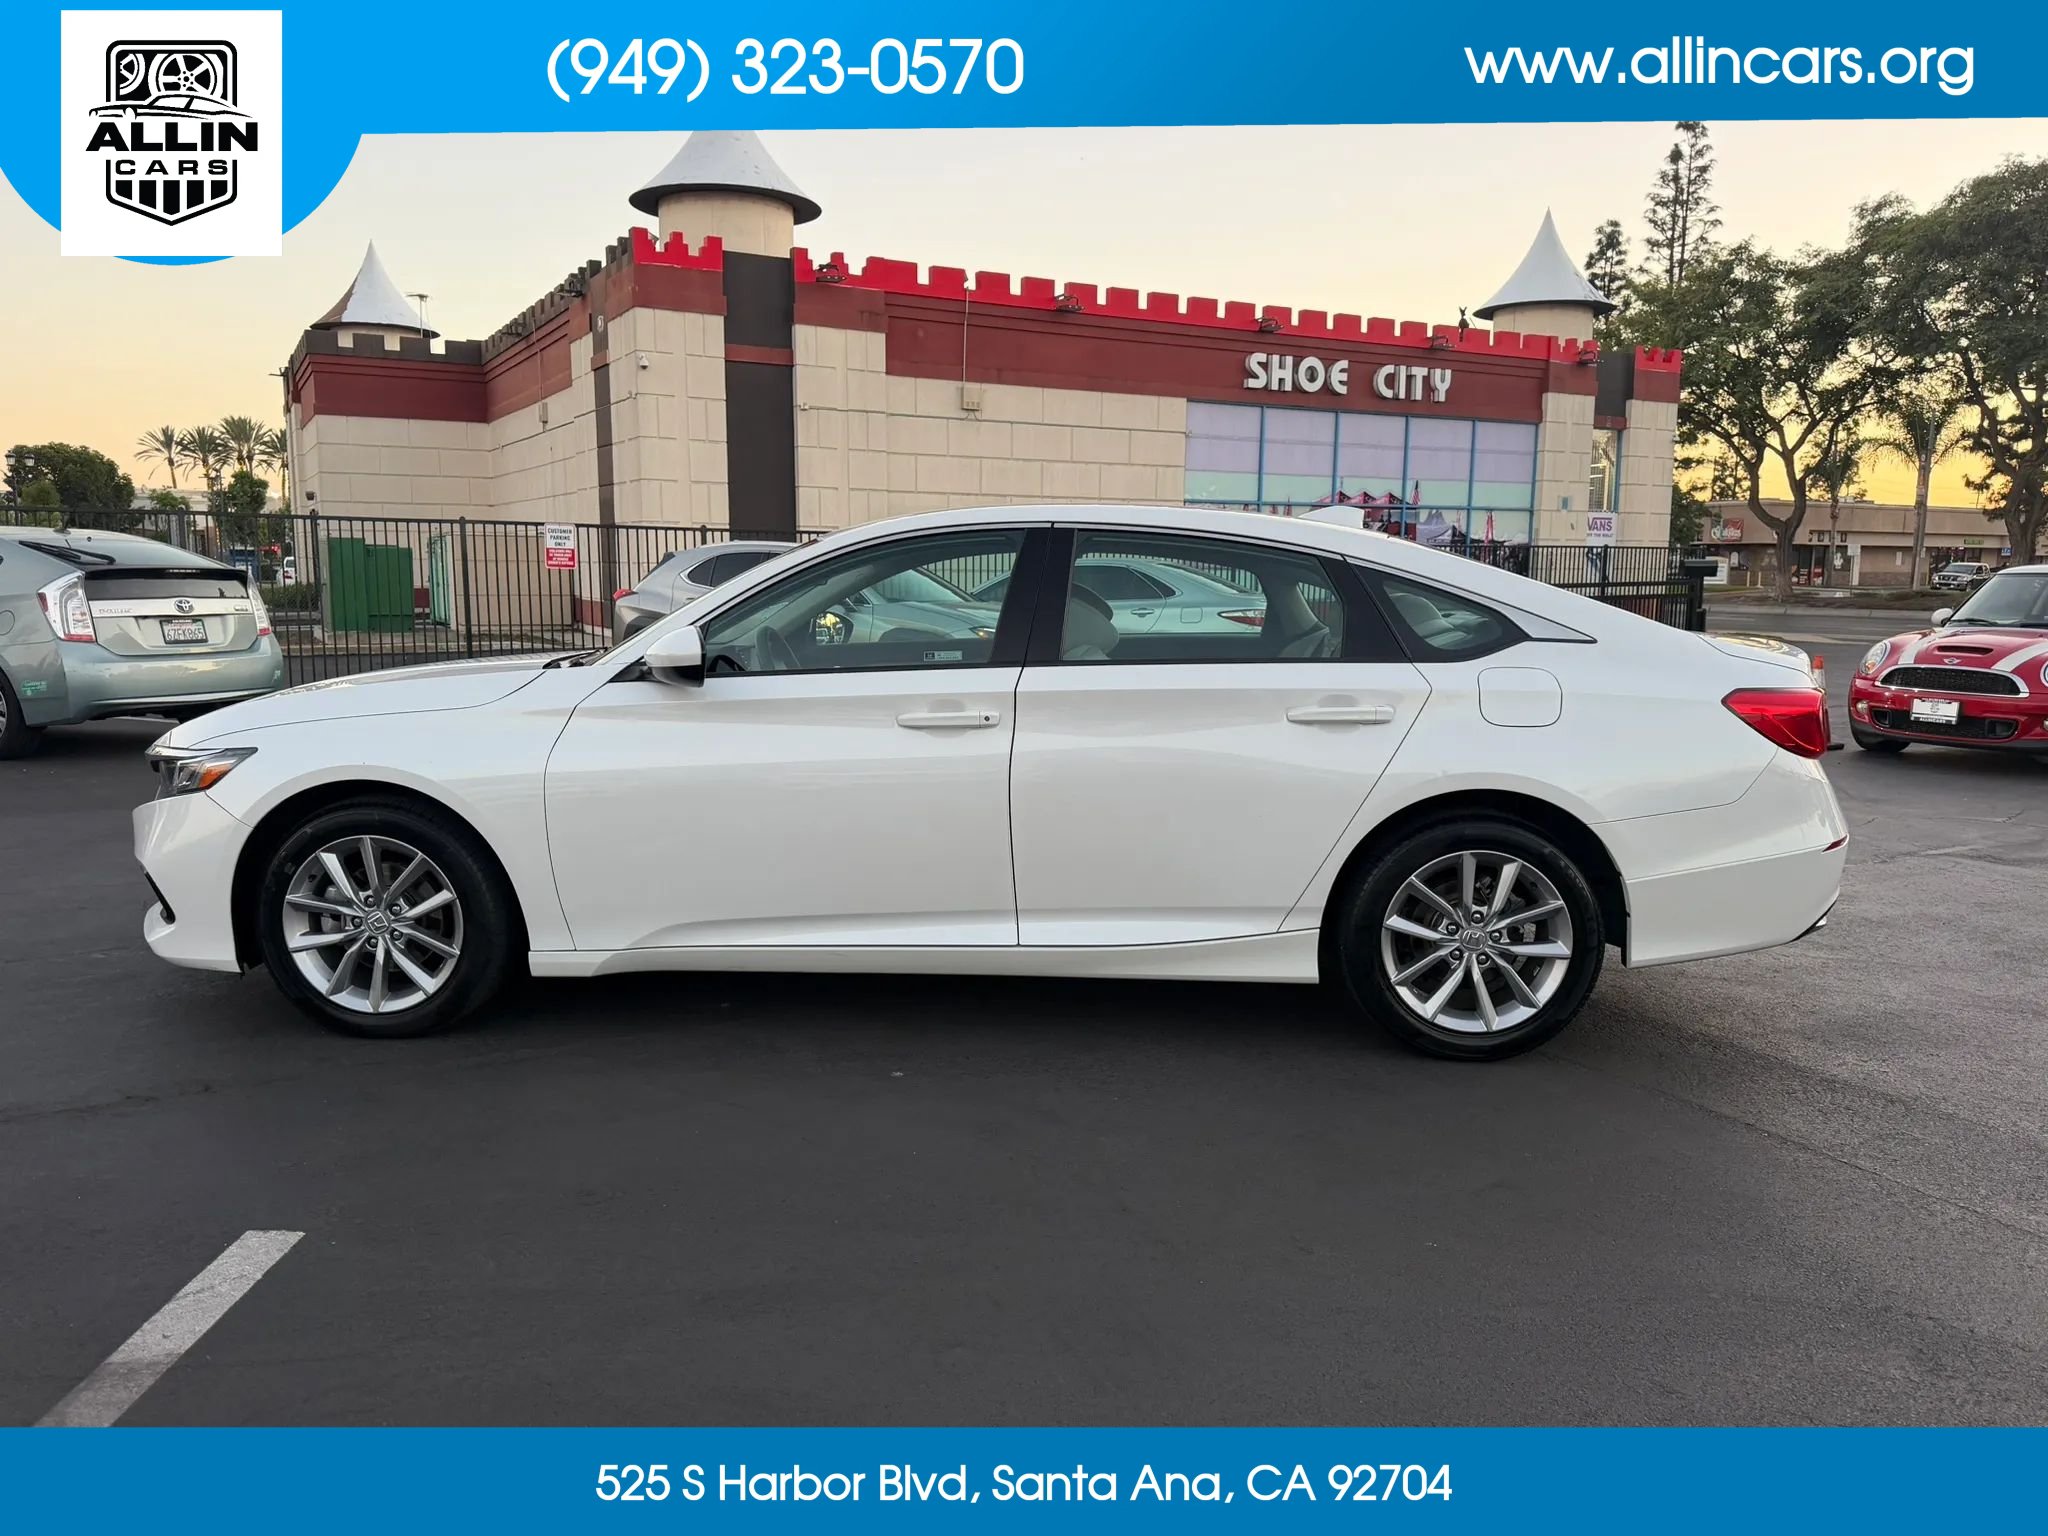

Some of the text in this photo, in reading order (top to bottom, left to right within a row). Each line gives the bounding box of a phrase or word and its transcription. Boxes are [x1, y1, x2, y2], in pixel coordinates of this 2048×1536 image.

[1244, 352, 1452, 402] SHOE CITY
[1587, 516, 1613, 531] VANS
